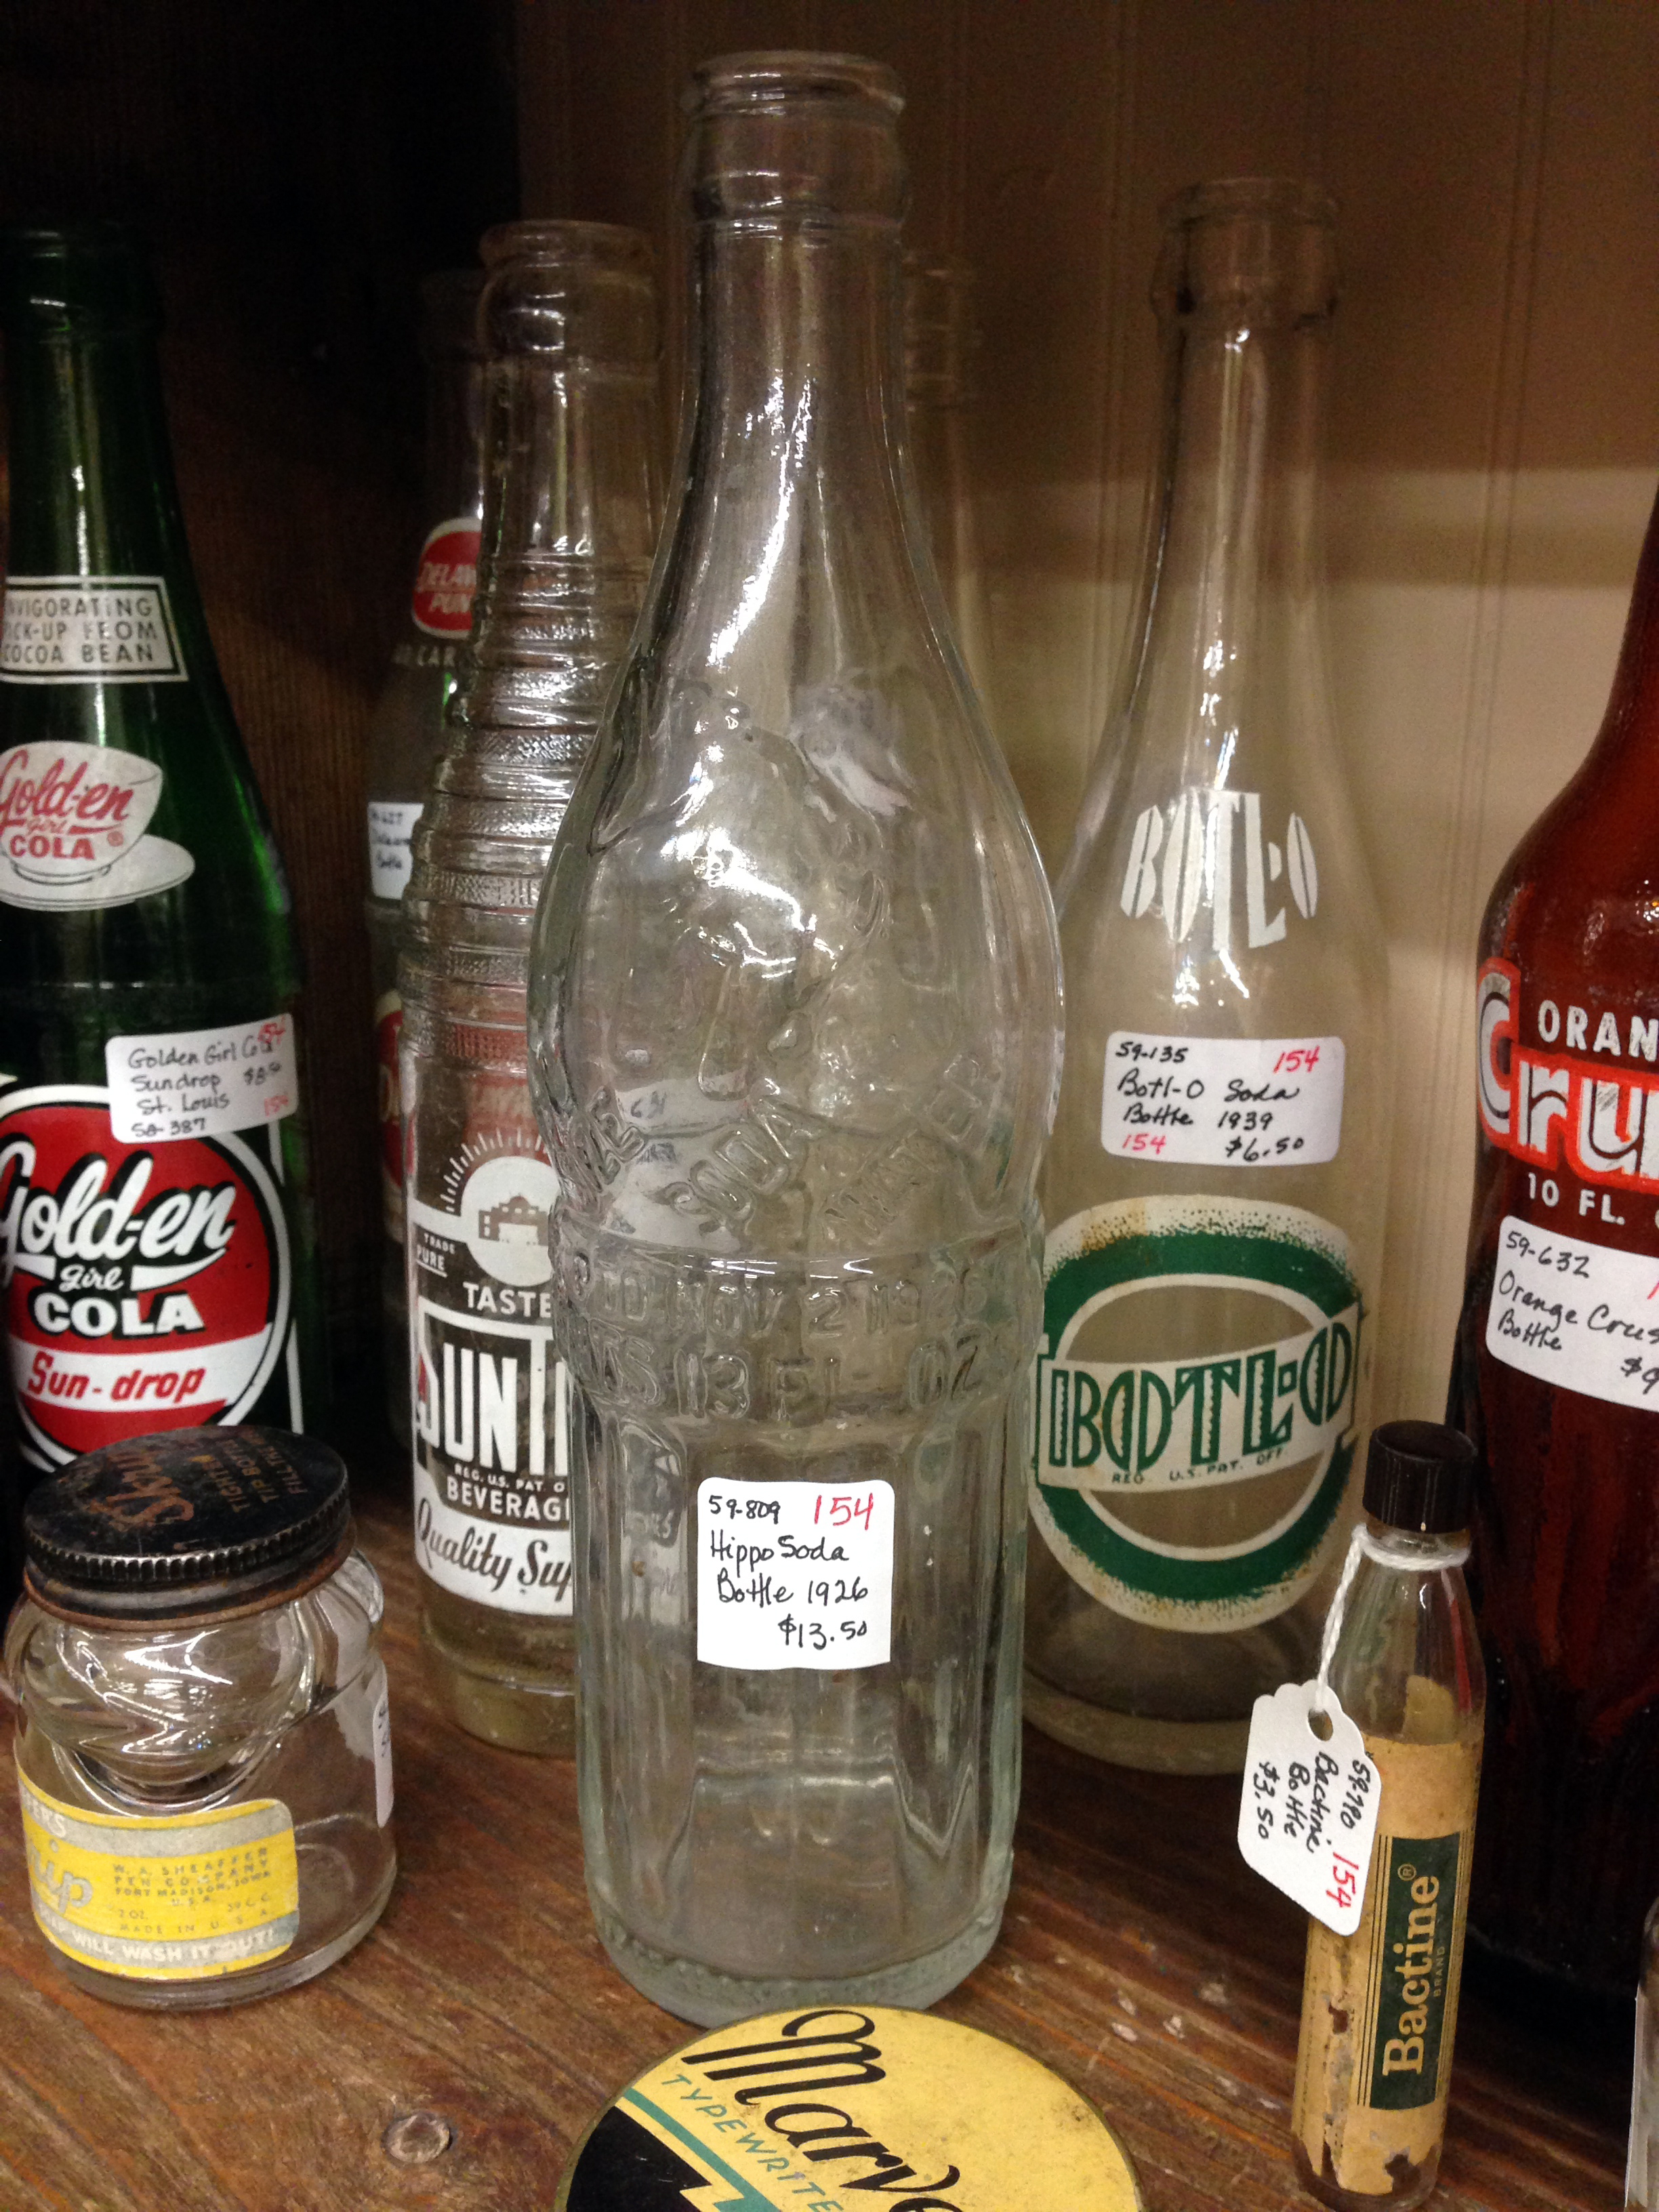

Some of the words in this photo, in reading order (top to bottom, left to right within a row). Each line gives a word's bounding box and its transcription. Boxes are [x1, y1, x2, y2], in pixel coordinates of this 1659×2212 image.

[81, 643, 154, 663] BEAN
[9, 835, 95, 860] COLA
[128, 1047, 200, 1069] Golden
[204, 1041, 237, 1065] Girl
[1115, 1041, 1189, 1063] 59-135
[1273, 1045, 1320, 1073] 154
[182, 1092, 230, 1112] Louis
[1224, 1078, 1300, 1103] Soda
[1123, 1102, 1194, 1126] Bottle
[1217, 1111, 1273, 1131] 1939
[1122, 1132, 1166, 1155] 154
[1225, 1136, 1305, 1162] $6.50
[1527, 1172, 1559, 1208] 10
[1578, 1188, 1626, 1225] FL.
[417, 1244, 445, 1271] PURE
[1505, 1230, 1590, 1279] 59-632
[33, 1291, 205, 1336] COLA
[1498, 1269, 1578, 1333] Orange
[1497, 1308, 1562, 1351] Bottle
[708, 1494, 781, 1525] 59-809
[814, 1492, 874, 1531] 154
[417, 1496, 512, 1593] Quality
[710, 1529, 775, 1578] Hippo
[777, 1534, 850, 1561] Soda
[717, 1567, 794, 1608] Bottle
[807, 1576, 869, 1607] 1926
[777, 1613, 868, 1650] $13.50
[1253, 1761, 1281, 1840] $3.50
[1283, 1761, 1311, 1839] Bottle
[115, 1887, 150, 1897] FORT
[1325, 1851, 1360, 1908] 154
[120, 1923, 163, 1935] MADE
[178, 1924, 194, 1935] IN
[122, 1943, 183, 1963] WASH
[1432, 1946, 1446, 1998] BRAND
[1382, 1875, 1441, 2077] Bactine
